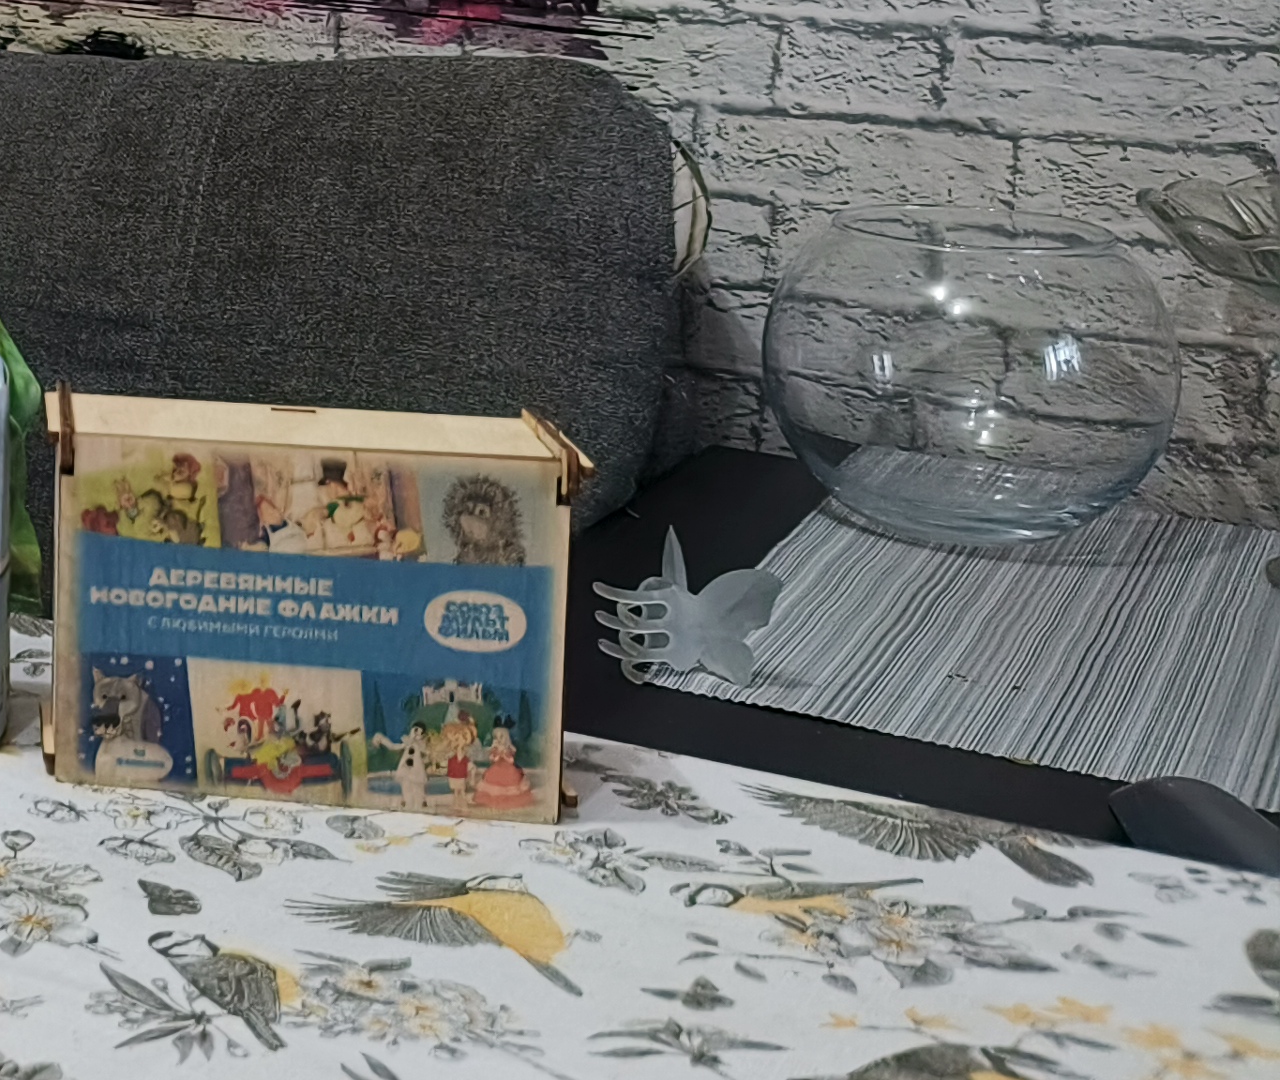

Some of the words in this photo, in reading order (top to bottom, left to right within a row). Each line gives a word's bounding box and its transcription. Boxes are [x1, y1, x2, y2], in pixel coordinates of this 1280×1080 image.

[148, 566, 334, 597] ДЕРЕВЯННЫЕ
[90, 585, 271, 615] НОВОГОДНИЕ
[277, 598, 399, 627] ФЛАЖКИ
[147, 615, 157, 629] С
[160, 617, 260, 637] ЛЮБИМЫМИ
[264, 626, 339, 641] ГЕРОЯМИ
